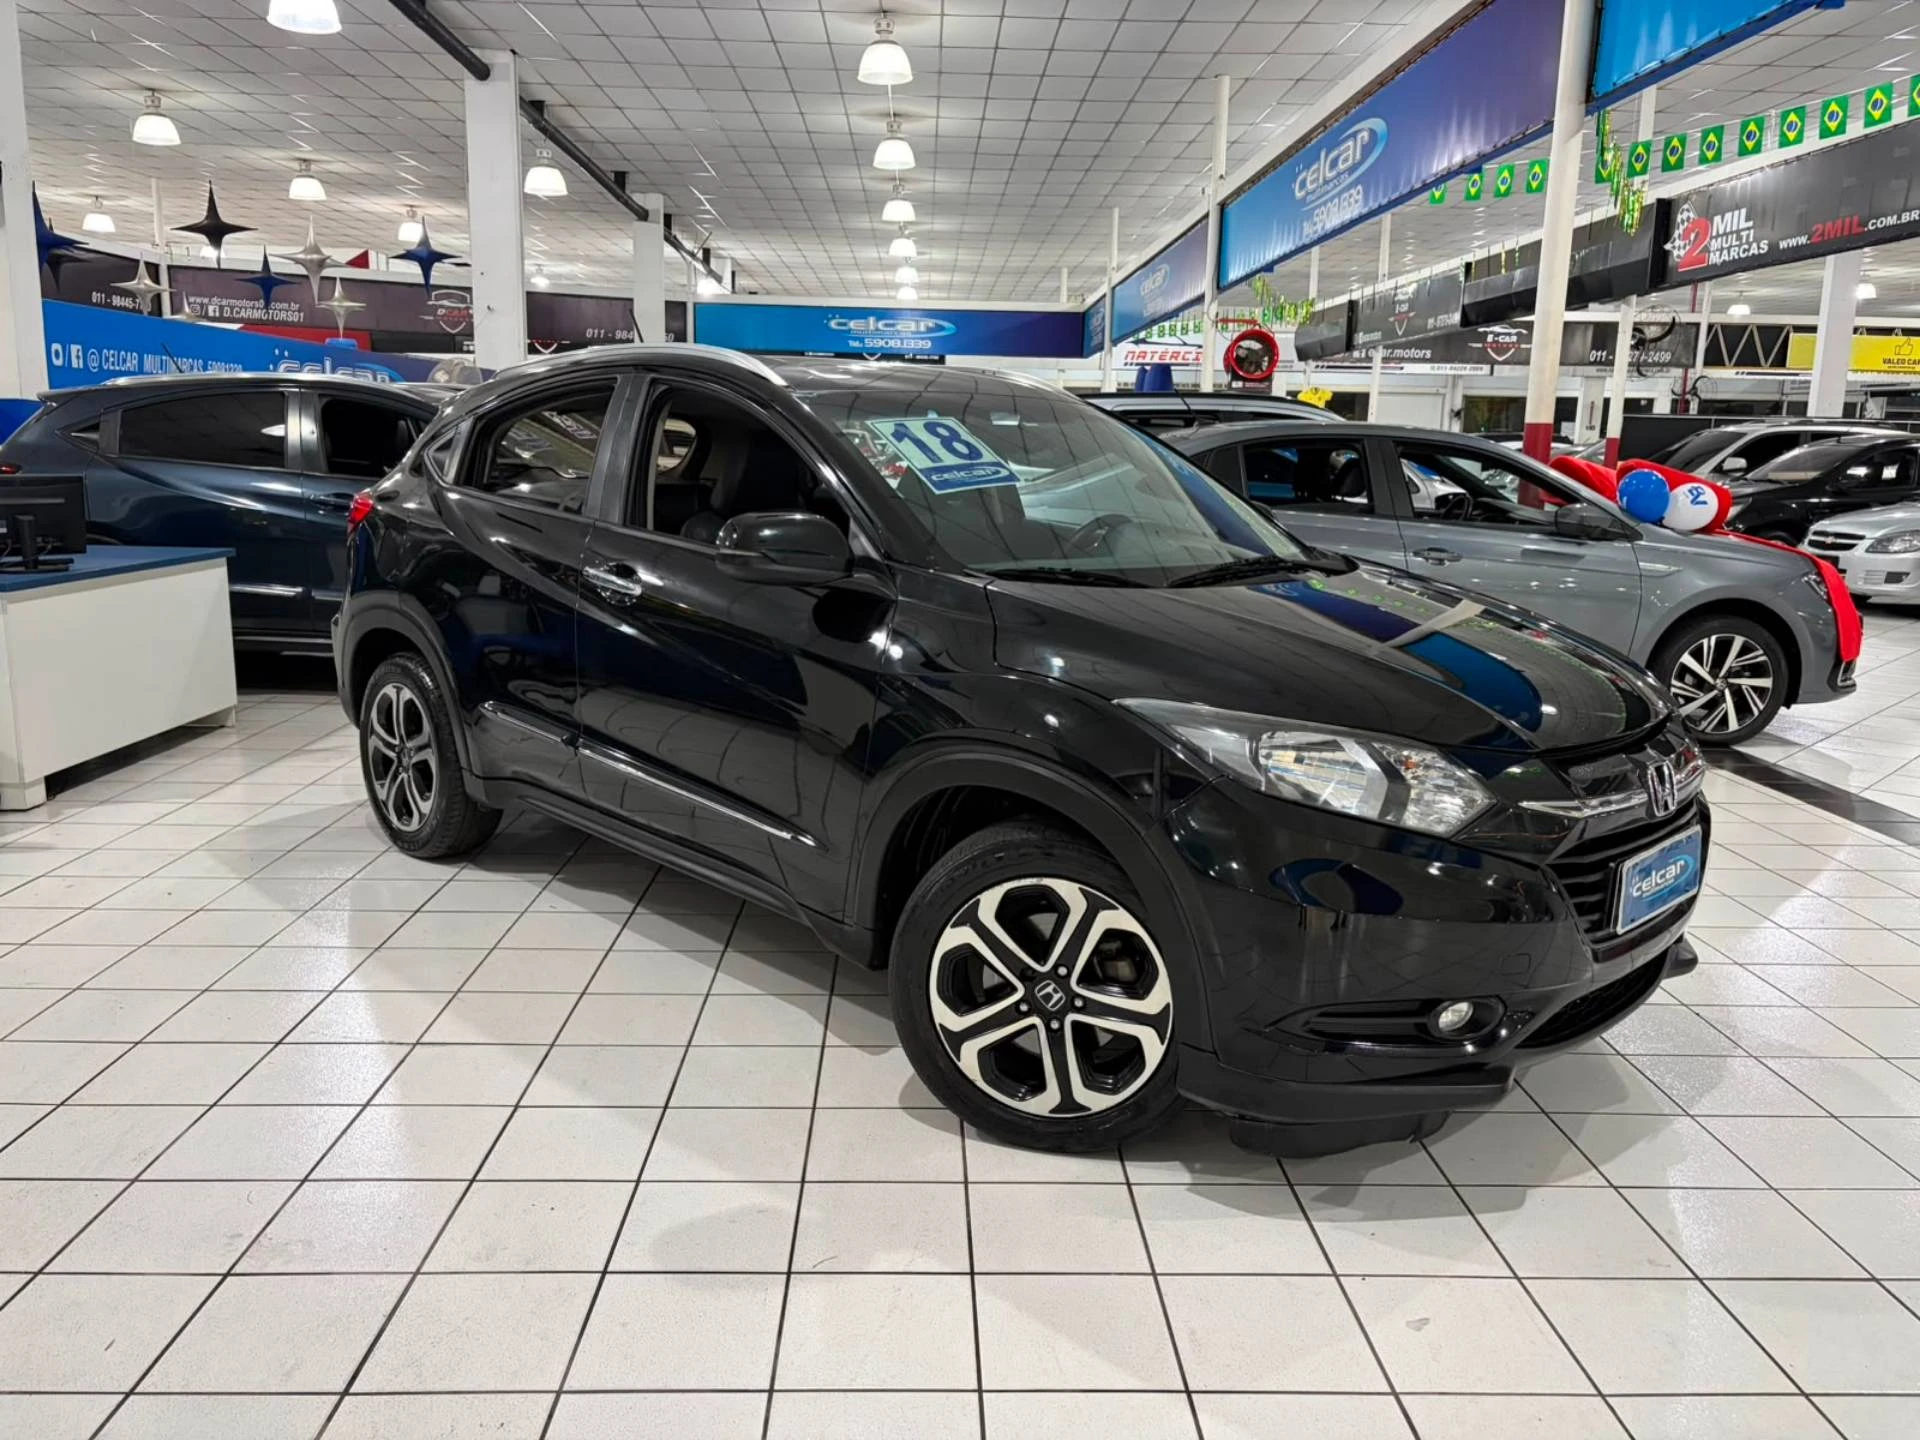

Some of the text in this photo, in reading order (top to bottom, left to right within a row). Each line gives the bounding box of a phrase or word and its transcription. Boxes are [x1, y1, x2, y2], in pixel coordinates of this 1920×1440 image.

[1294, 127, 1370, 201] celcar
[1712, 207, 1753, 236] MIL
[1678, 216, 1711, 272] 2
[1711, 229, 1754, 250] MULTI
[1709, 240, 1768, 265] MARCAS
[189, 295, 299, 310] www.dcarmotors0.com.br
[586, 328, 605, 339] 011
[615, 329, 634, 340] 984
[829, 316, 936, 332] celcar
[102, 349, 139, 373] CELCAR
[1124, 347, 1203, 362] NATÉRCI
[1589, 350, 1607, 362] 011
[891, 422, 983, 464] 18
[931, 467, 997, 482] celcar
[1632, 859, 1685, 898] celcar
